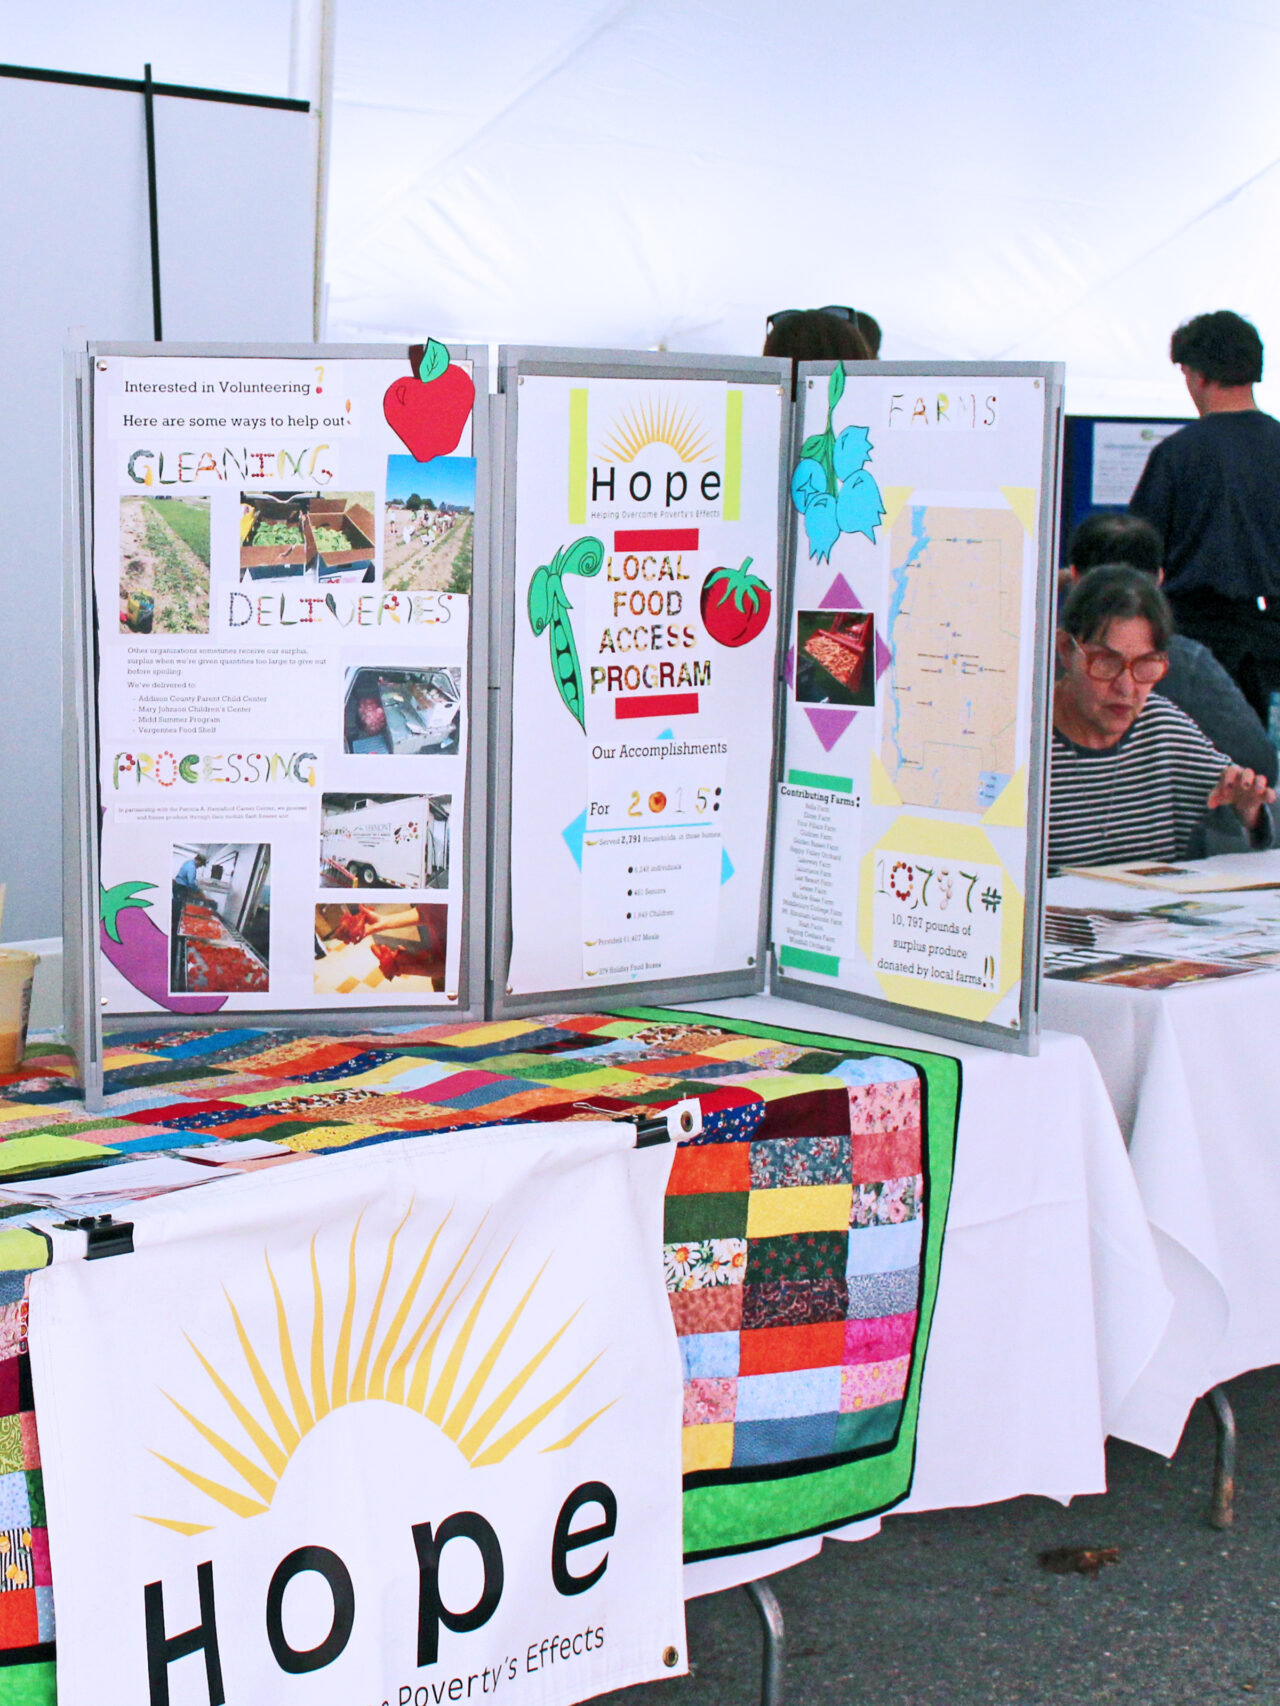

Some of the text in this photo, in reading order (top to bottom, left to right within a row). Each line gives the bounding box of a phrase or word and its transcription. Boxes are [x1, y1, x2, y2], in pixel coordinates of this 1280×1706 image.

[124, 381, 197, 393] Interested
[201, 381, 215, 393] in
[123, 415, 159, 427] Here
[162, 418, 185, 427] are
[189, 418, 227, 427] some
[231, 418, 267, 430] ways
[270, 416, 284, 427] to
[288, 414, 319, 430] help
[889, 392, 996, 429] FARMS
[127, 445, 333, 487] GLEANING
[591, 466, 721, 507] Hope
[591, 509, 720, 520] Helping Overcome Poverty's Effects
[607, 554, 691, 582] LOCAL
[229, 592, 453, 629] DELIVERIES
[613, 590, 683, 617] FOOD
[599, 624, 697, 654] ACCESS
[590, 660, 711, 695] PROGRAM
[592, 742, 728, 760] Our Accomplishments
[113, 750, 318, 790] PROCESSING
[780, 786, 829, 804] Contributing
[590, 802, 610, 816] For
[621, 834, 641, 845] 2,791
[925, 921, 959, 934] pounds
[962, 925, 972, 936] of
[893, 939, 968, 959] surplus produce
[878, 957, 915, 974] donated
[917, 963, 929, 978] by
[931, 966, 954, 981] local
[144, 1480, 618, 1706] Hope
[399, 1626, 605, 1706] Poverty's Effects
